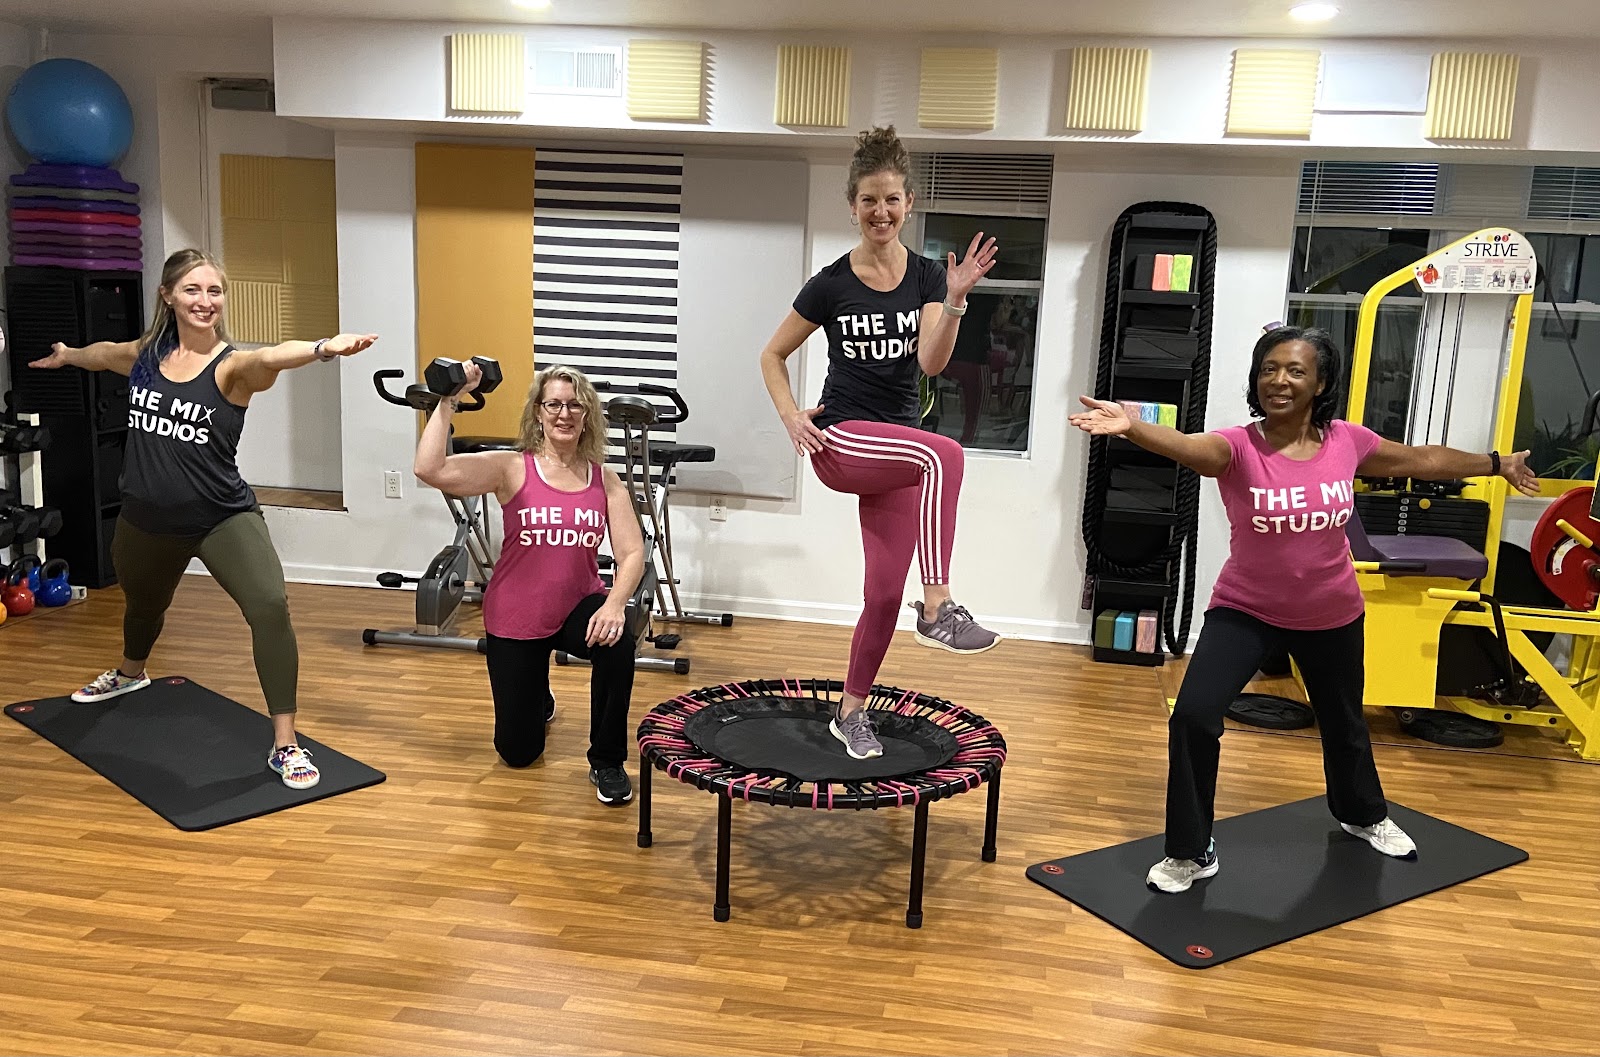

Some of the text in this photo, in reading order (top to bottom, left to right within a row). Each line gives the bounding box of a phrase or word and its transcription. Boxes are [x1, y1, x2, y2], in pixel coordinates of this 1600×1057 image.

[1464, 242, 1519, 257] STRIVE
[837, 313, 886, 336] THE
[842, 336, 919, 360] STUDIO
[1249, 486, 1307, 510] THE
[517, 507, 562, 526] THE
[1252, 508, 1354, 533] STUDIO
